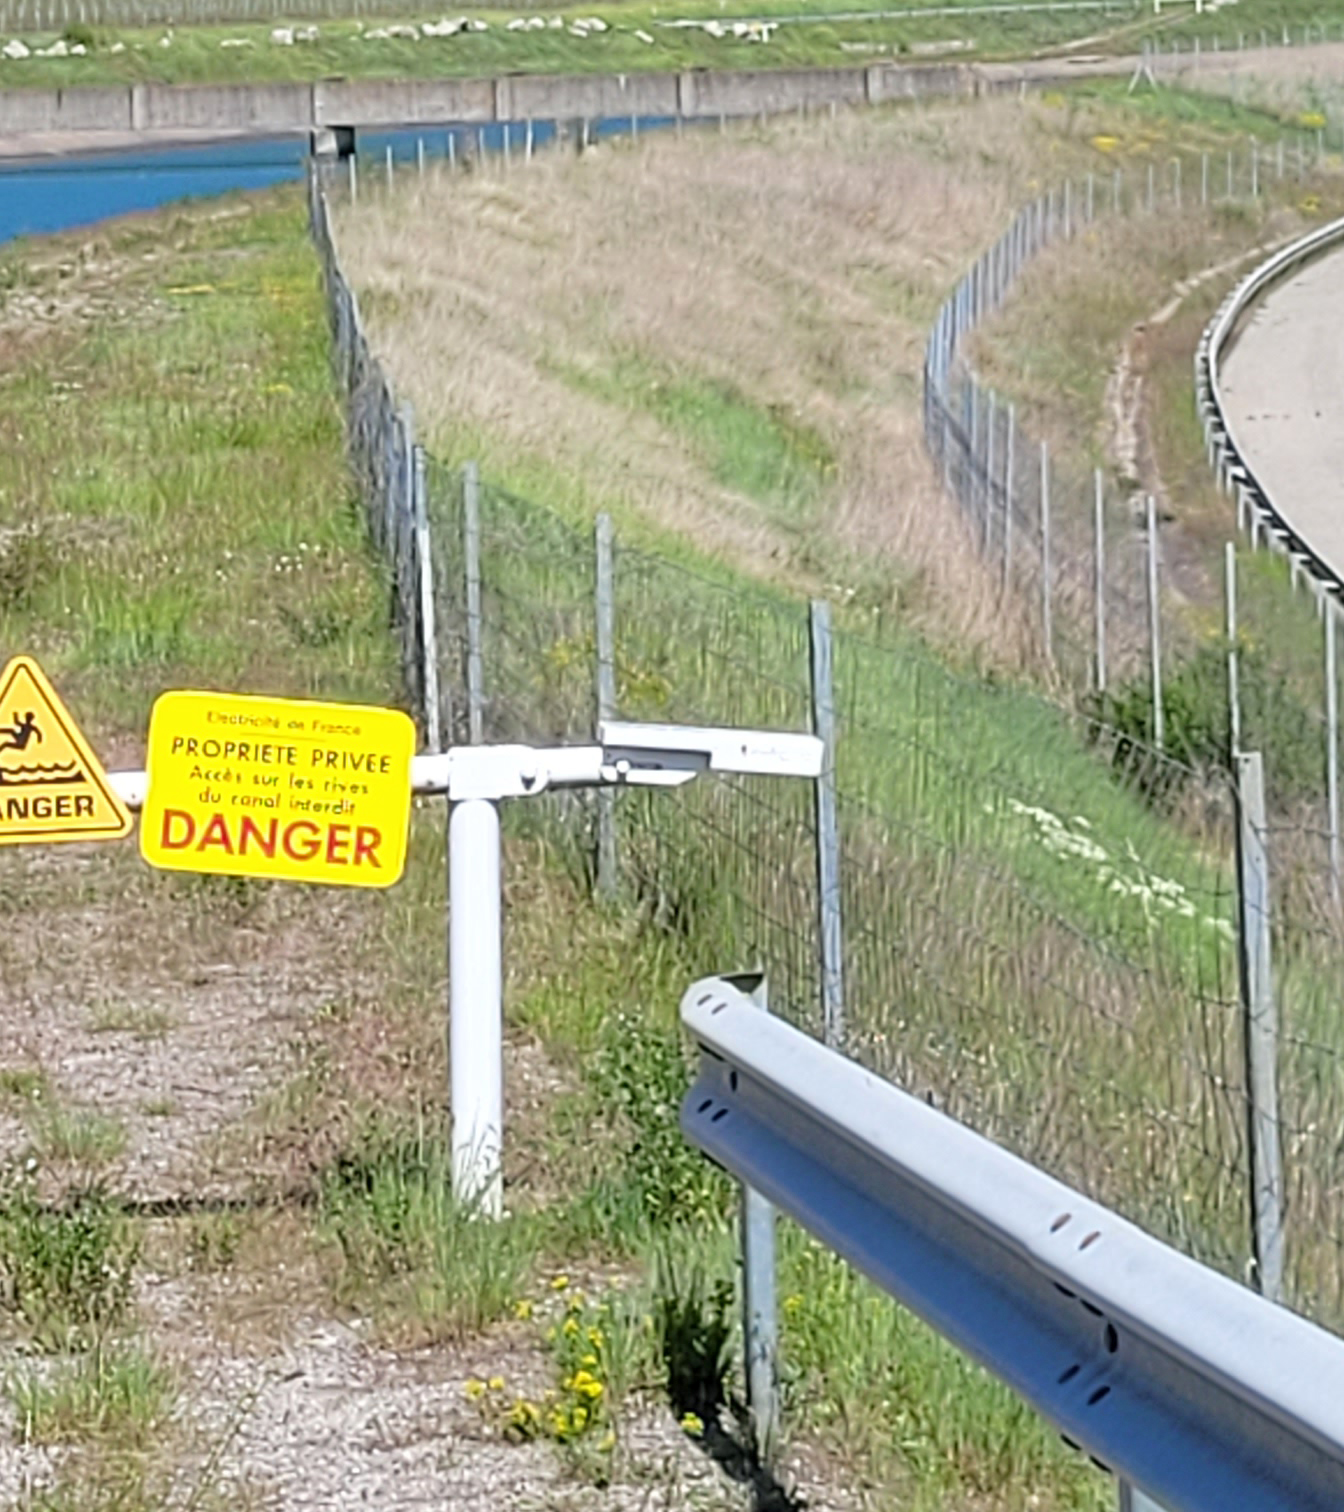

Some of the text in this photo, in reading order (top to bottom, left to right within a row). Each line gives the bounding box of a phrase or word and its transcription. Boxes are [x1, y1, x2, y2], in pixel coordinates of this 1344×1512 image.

[171, 736, 391, 774] PROPRIETE PRIVEE
[253, 773, 279, 787] sur
[289, 773, 314, 790] les
[324, 777, 369, 795] rives
[198, 787, 356, 816] du canal interdit
[159, 808, 383, 869] DANGER
